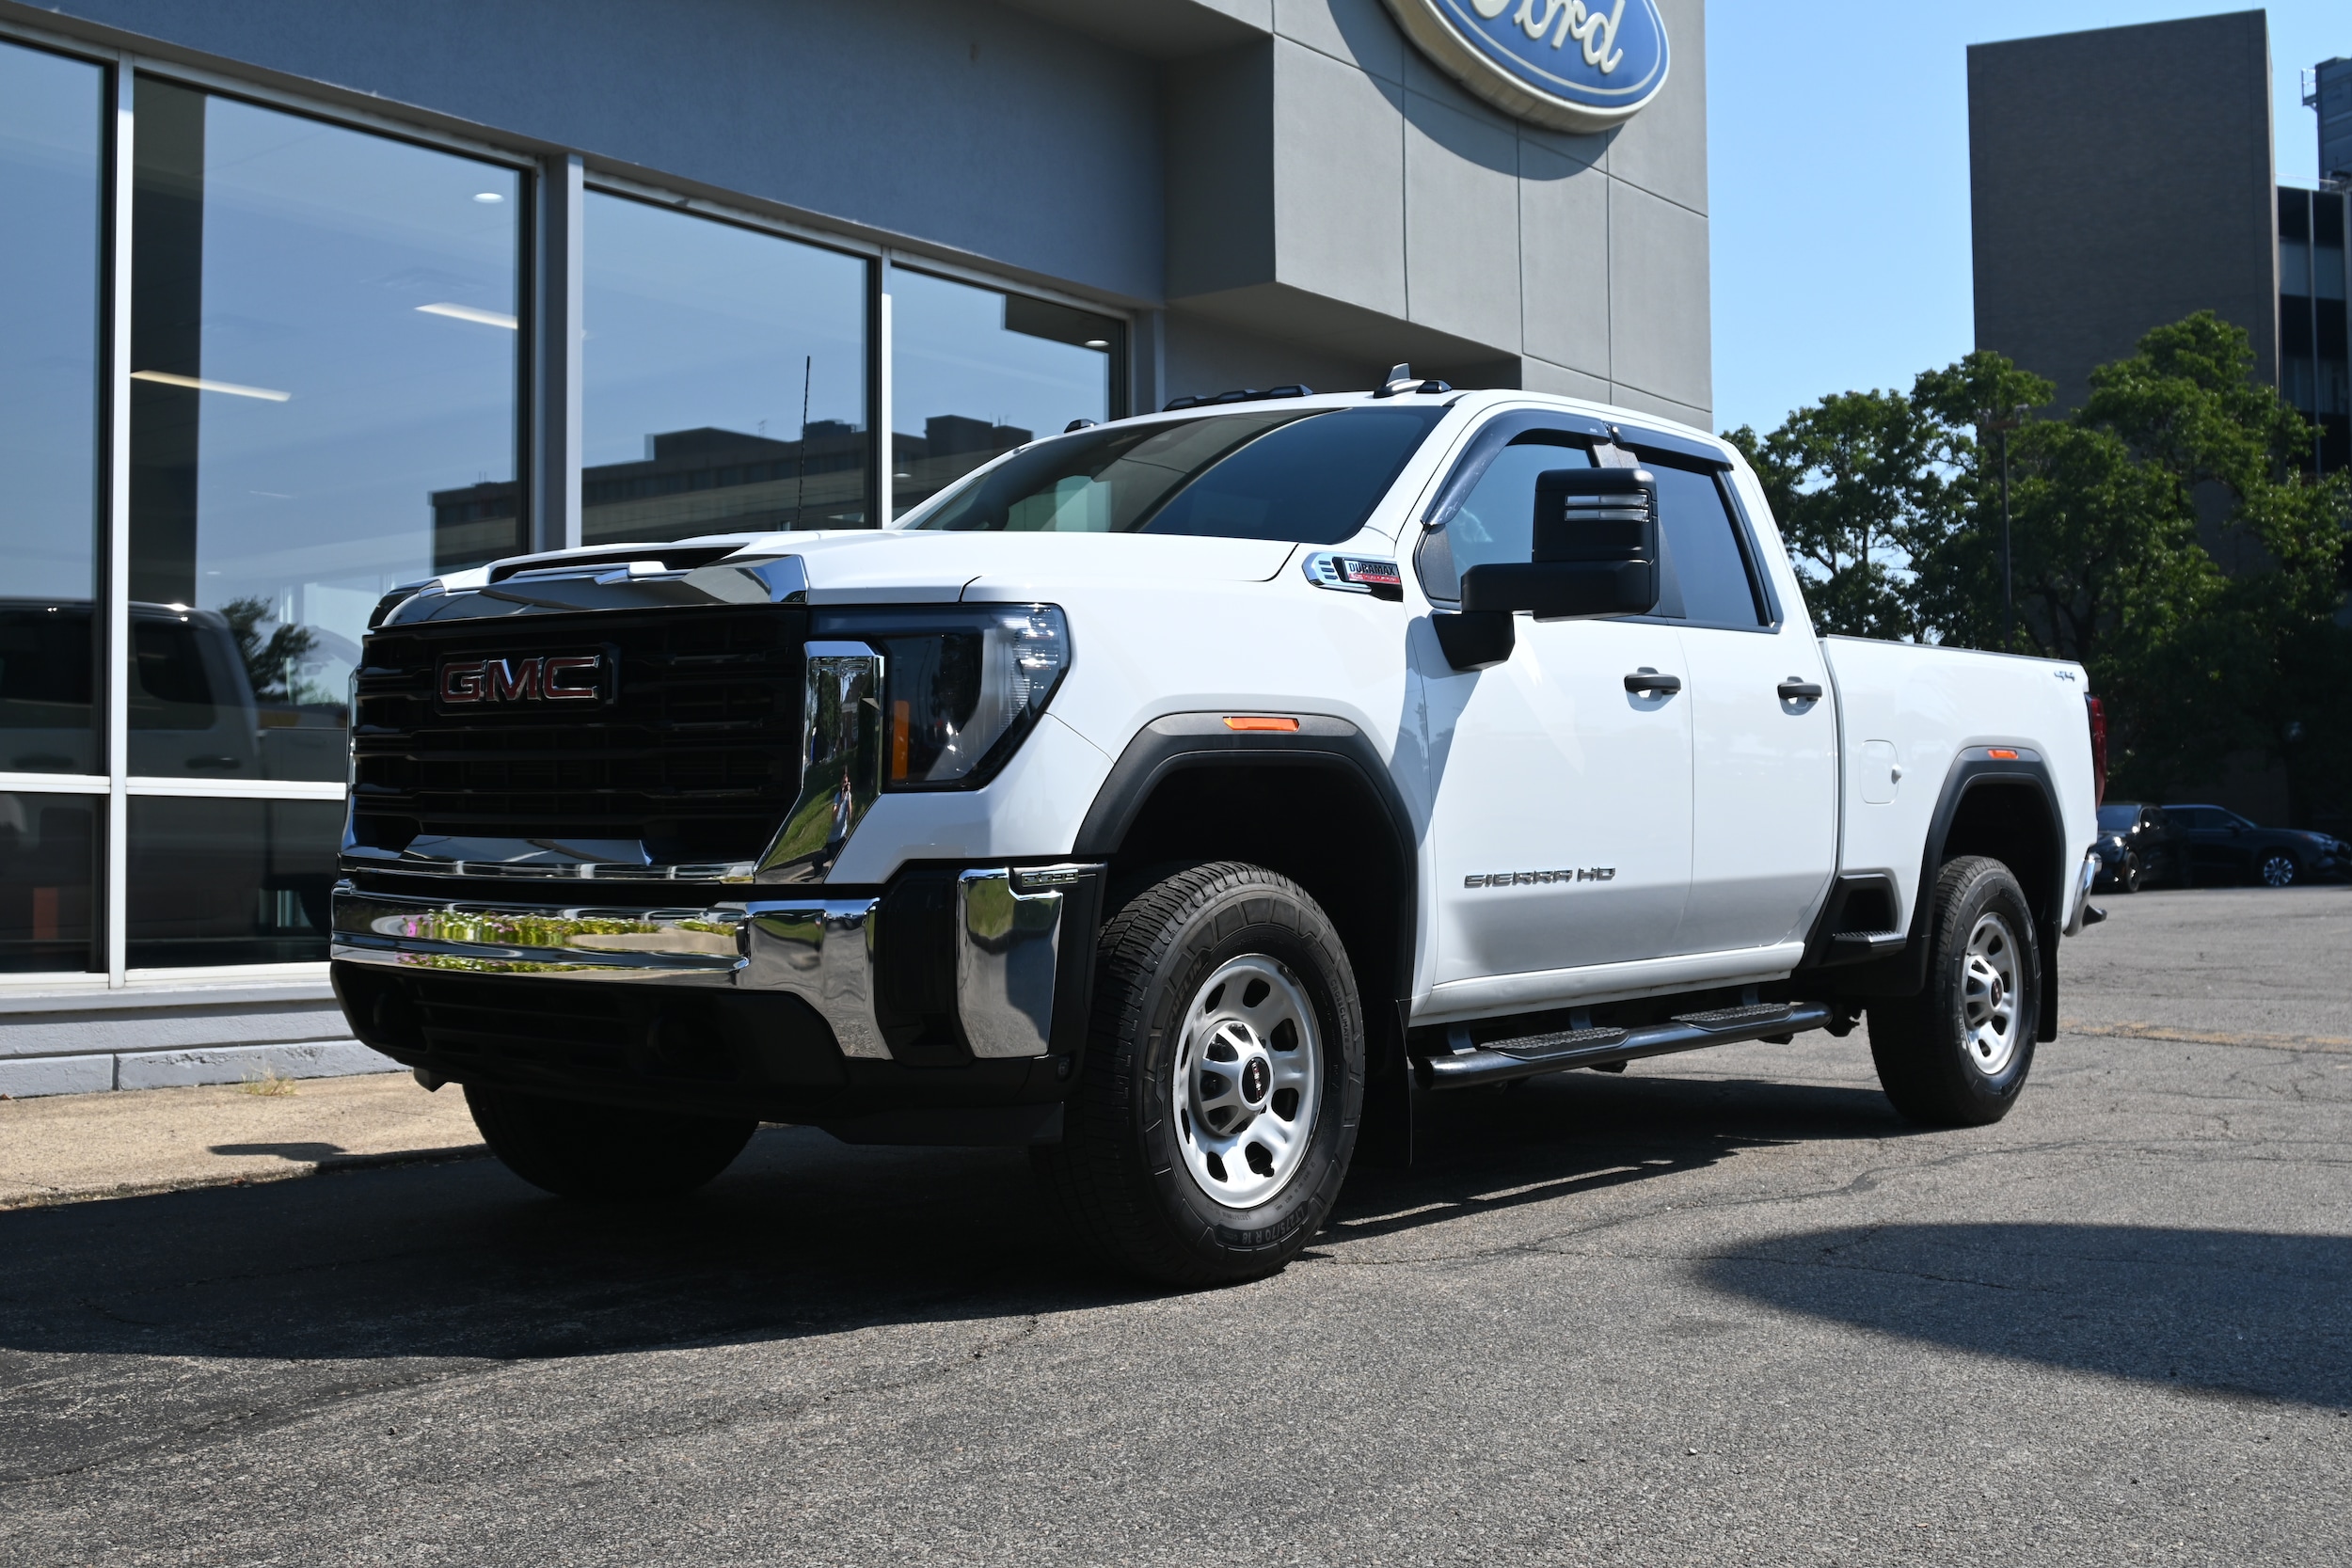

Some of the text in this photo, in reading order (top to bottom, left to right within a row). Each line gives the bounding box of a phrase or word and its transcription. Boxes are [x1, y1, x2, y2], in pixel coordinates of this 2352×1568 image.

[1471, 0, 1626, 74] ord
[1348, 562, 1396, 576] DURAMAX
[440, 655, 600, 703] GMC
[1464, 867, 1616, 889] SIERRA HD
